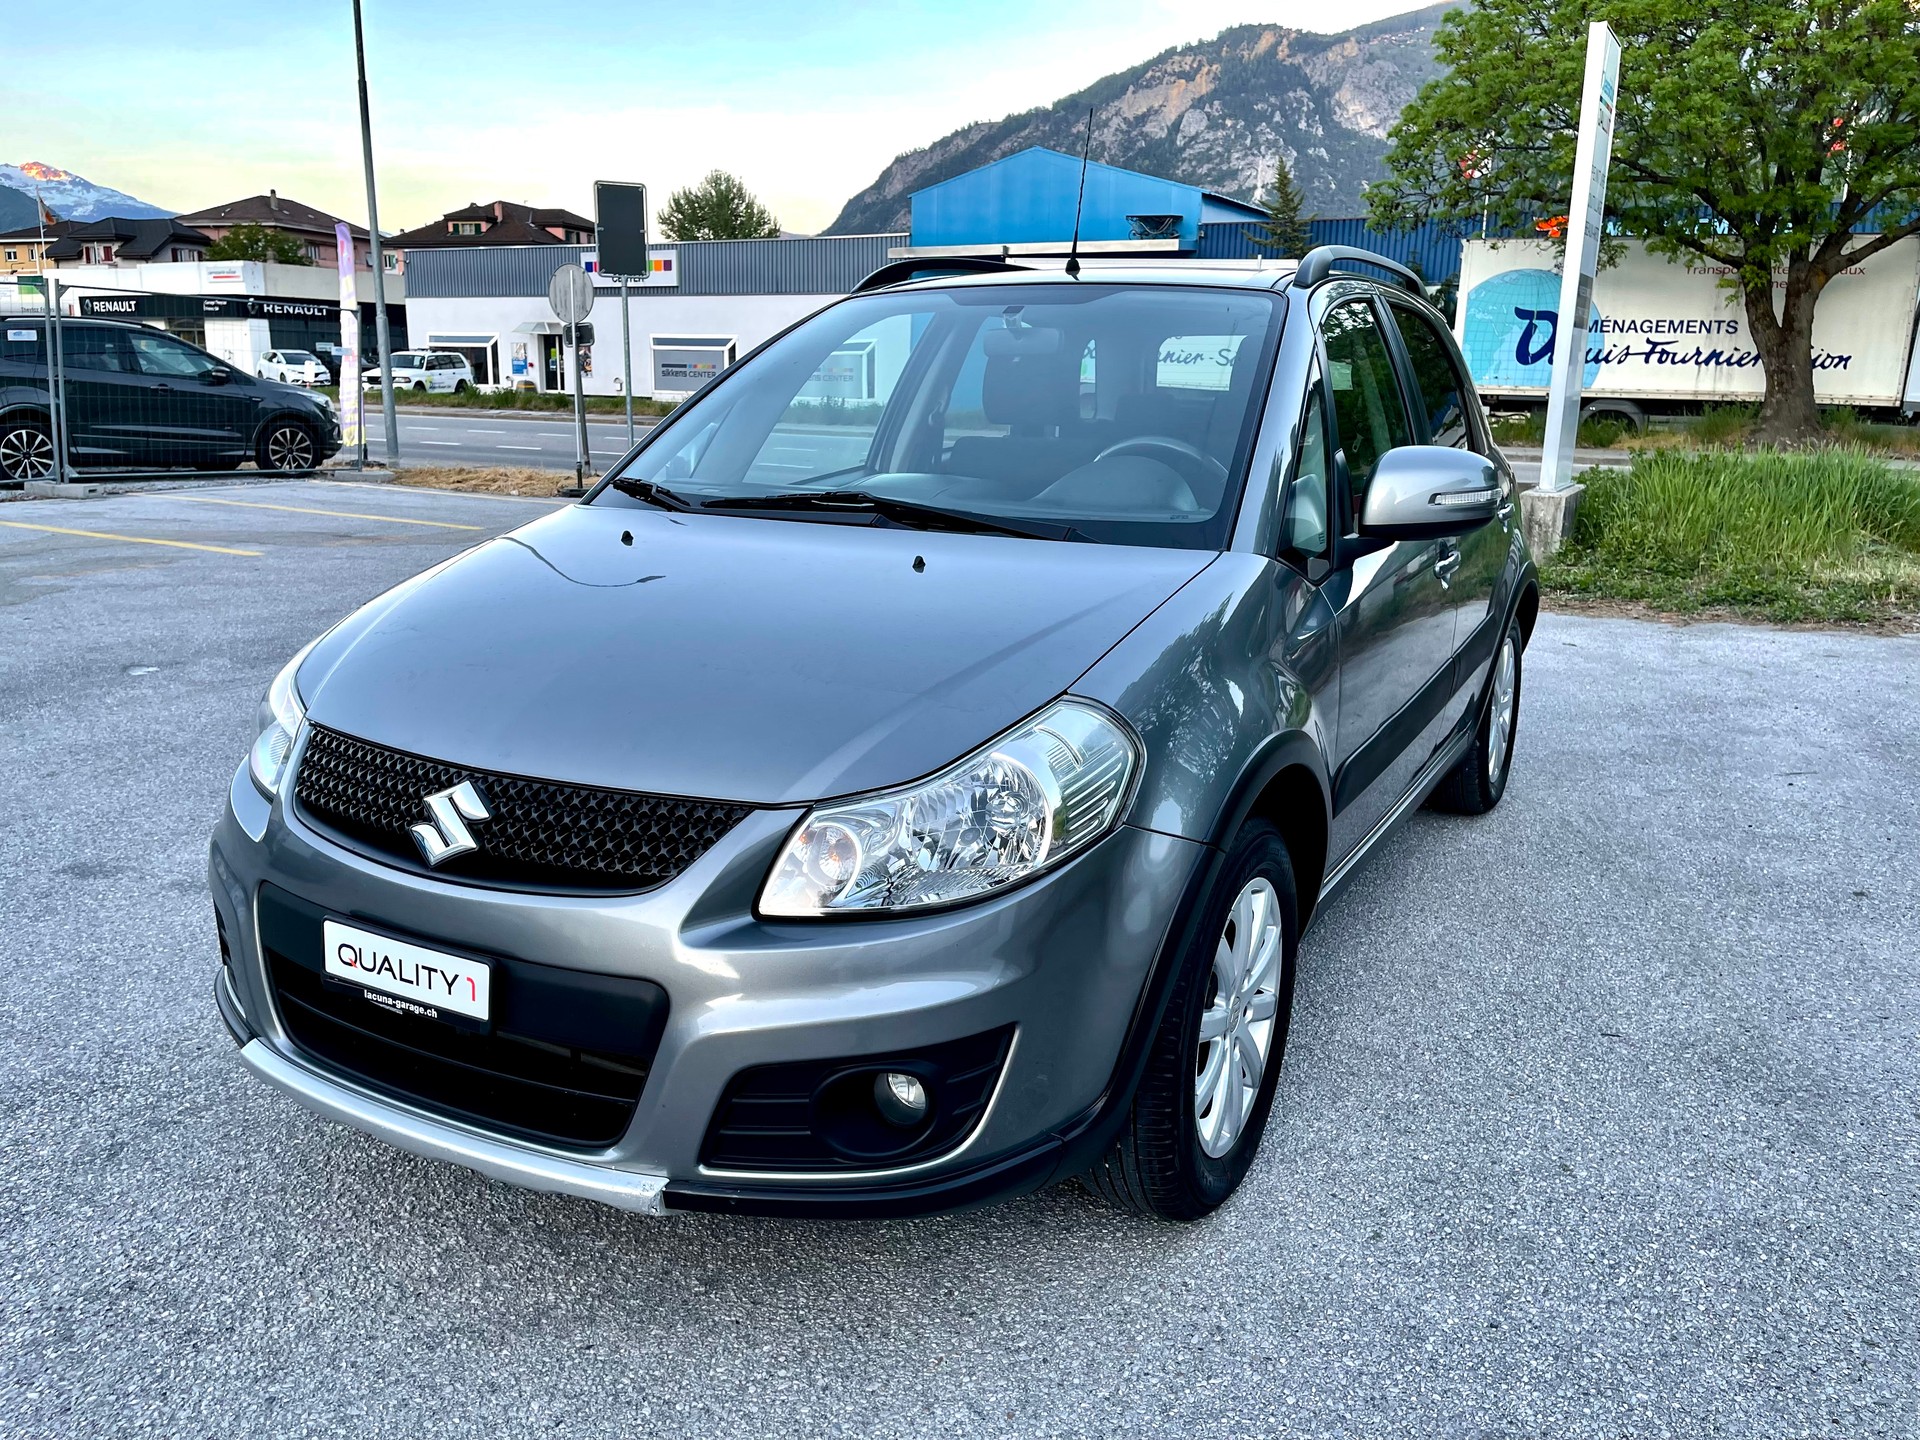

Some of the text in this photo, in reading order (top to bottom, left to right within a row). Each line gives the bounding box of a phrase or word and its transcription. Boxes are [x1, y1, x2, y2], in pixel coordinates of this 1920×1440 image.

[1686, 265, 1739, 278] Transpo
[93, 300, 136, 312] RENAULT
[263, 303, 328, 316] RENAULT
[1588, 315, 1738, 334] MÉNAGEMENTS
[1811, 345, 1853, 371] ion
[688, 370, 716, 378] CENTER
[337, 942, 460, 996] QUALITY
[363, 989, 438, 1019] lacuna-garage.ch
